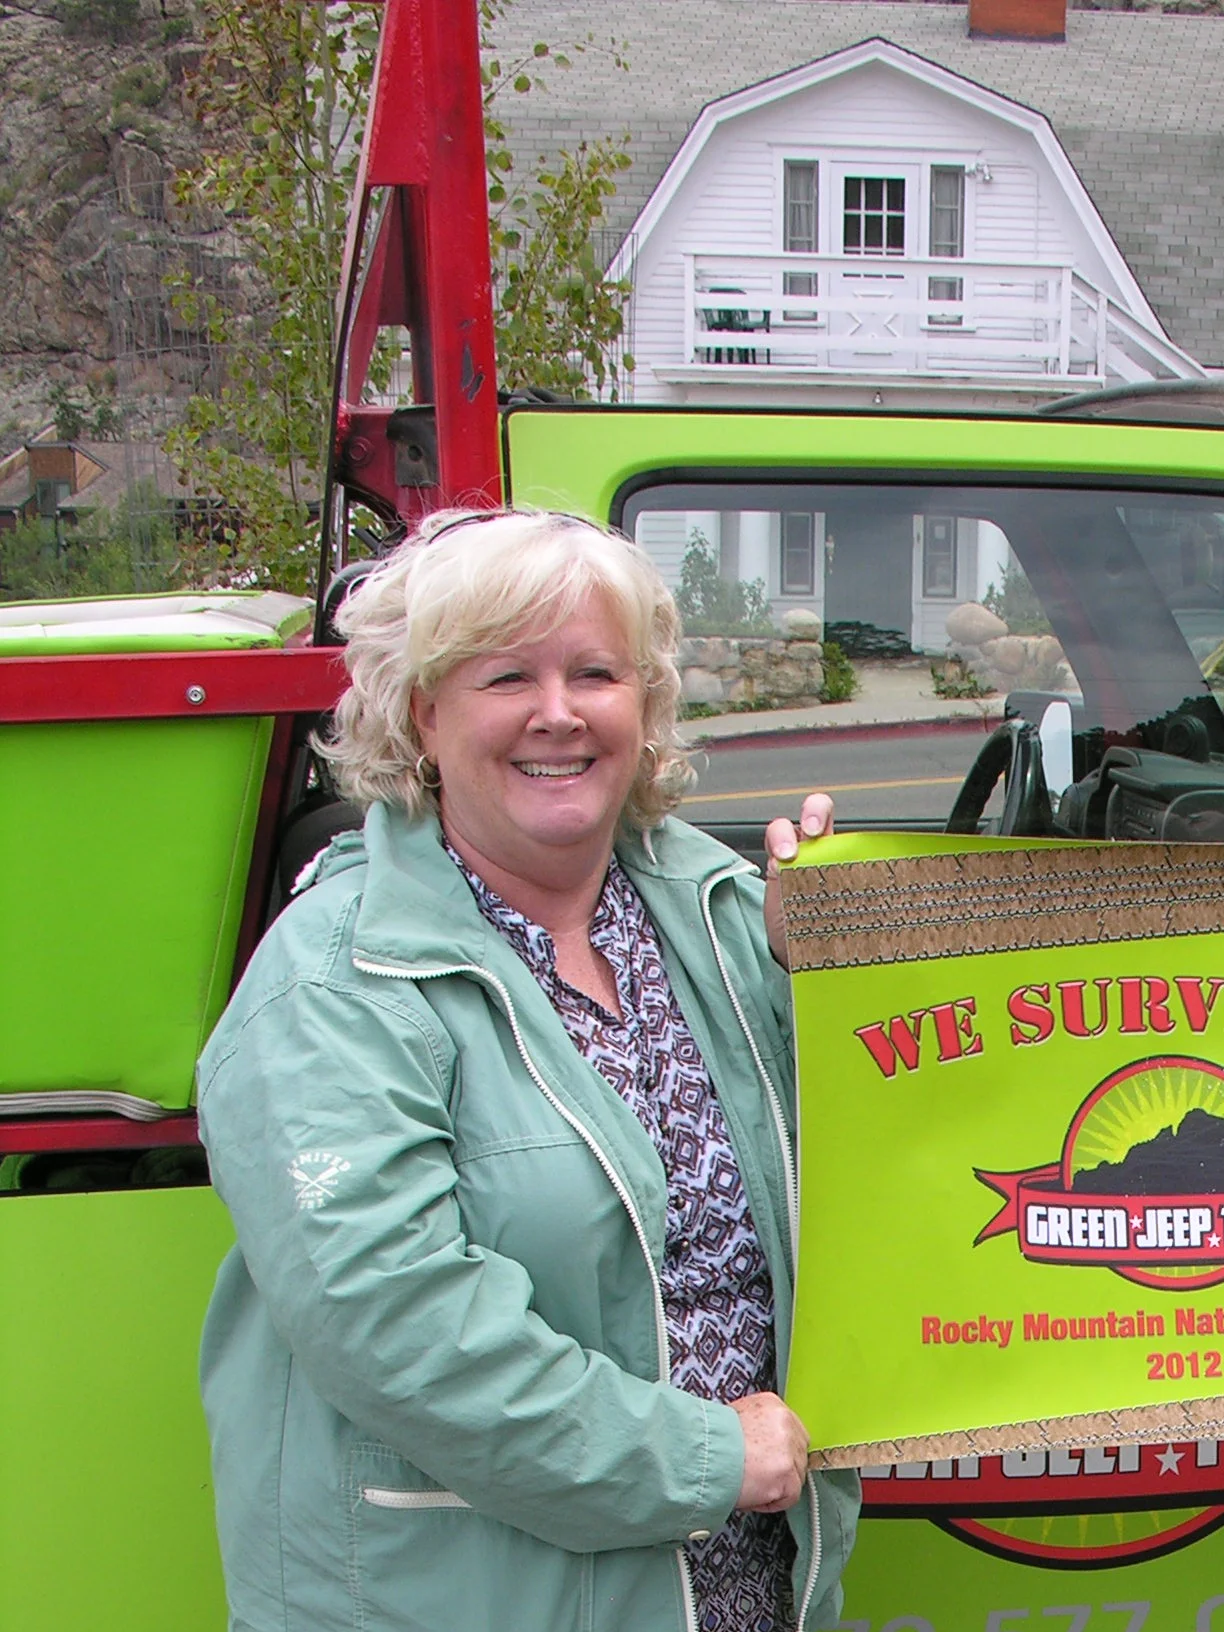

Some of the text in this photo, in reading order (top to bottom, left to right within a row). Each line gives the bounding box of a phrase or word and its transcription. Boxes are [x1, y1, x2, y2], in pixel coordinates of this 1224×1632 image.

[853, 996, 985, 1079] WE
[1026, 1205, 1129, 1248] GREEN
[1134, 1206, 1212, 1248] JEEP
[921, 1313, 1014, 1349] Rocky
[1022, 1309, 1166, 1343] Mountain
[1146, 1350, 1224, 1381] 2012
